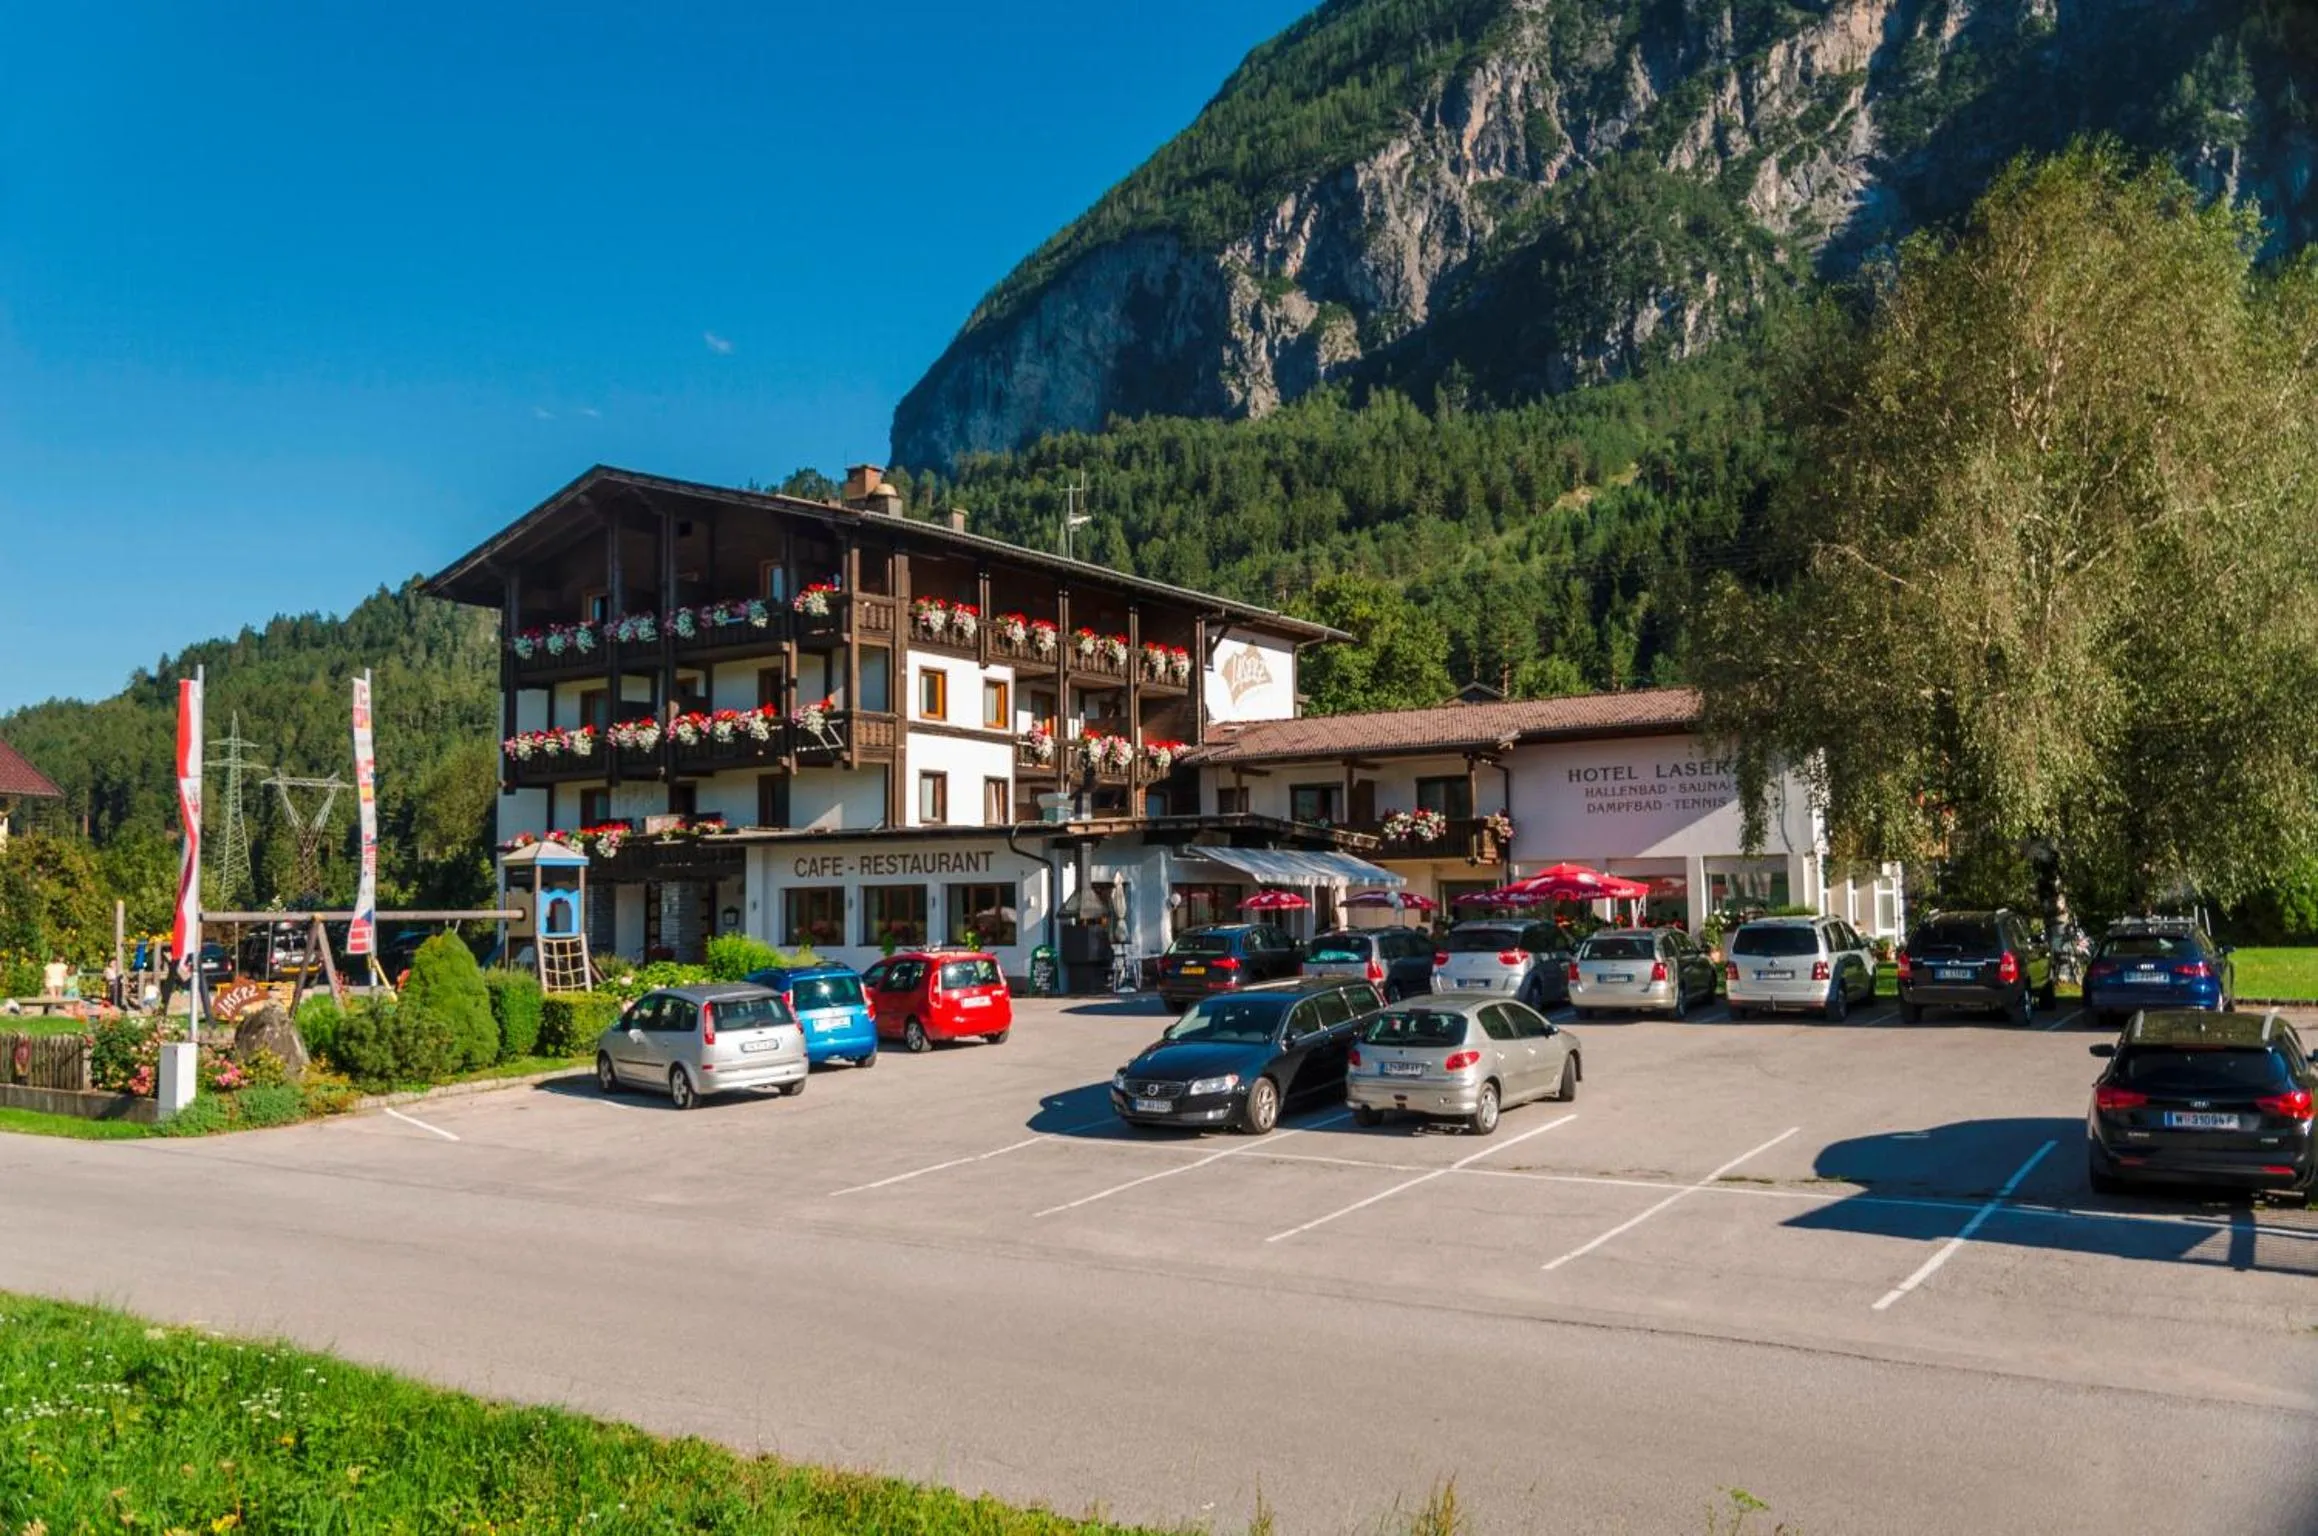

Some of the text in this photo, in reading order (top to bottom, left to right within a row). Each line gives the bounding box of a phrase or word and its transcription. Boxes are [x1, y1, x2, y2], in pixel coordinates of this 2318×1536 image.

[1568, 761, 1744, 783] HOTEL LASER
[1584, 784, 1667, 798] HALLENBAD
[1678, 780, 1729, 794] SAUNA
[1586, 800, 1662, 814] DAMPFBAD
[1673, 797, 1727, 811] TENNIS
[793, 856, 844, 878] CAFE
[859, 850, 995, 876] RESTAURANT
